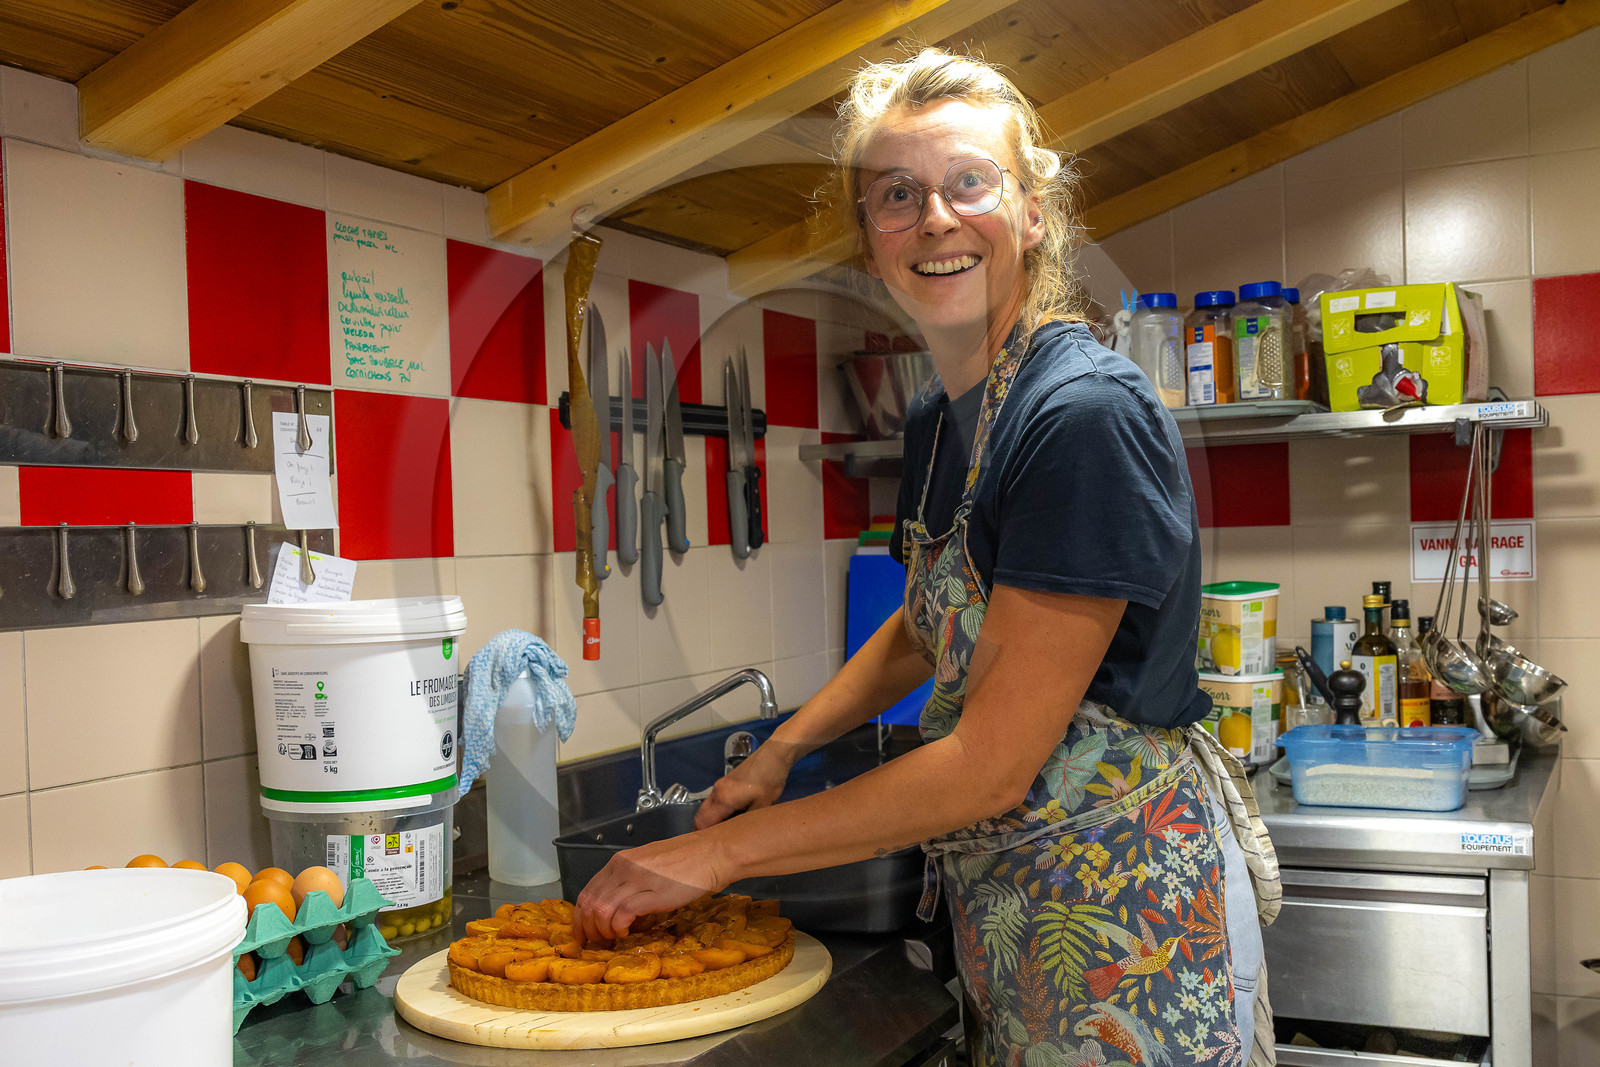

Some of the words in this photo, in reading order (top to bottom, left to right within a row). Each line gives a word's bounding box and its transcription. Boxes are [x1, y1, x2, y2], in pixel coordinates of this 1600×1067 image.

[385, 244, 398, 253] WC
[1420, 538, 1461, 550] VANN
[410, 680, 421, 696] LE
[424, 674, 454, 694] FROMAGE
[430, 696, 440, 708] DES
[330, 766, 338, 774] kg
[1462, 833, 1512, 845] TOURNUS
[1462, 844, 1512, 852] EQUIPEMENT
